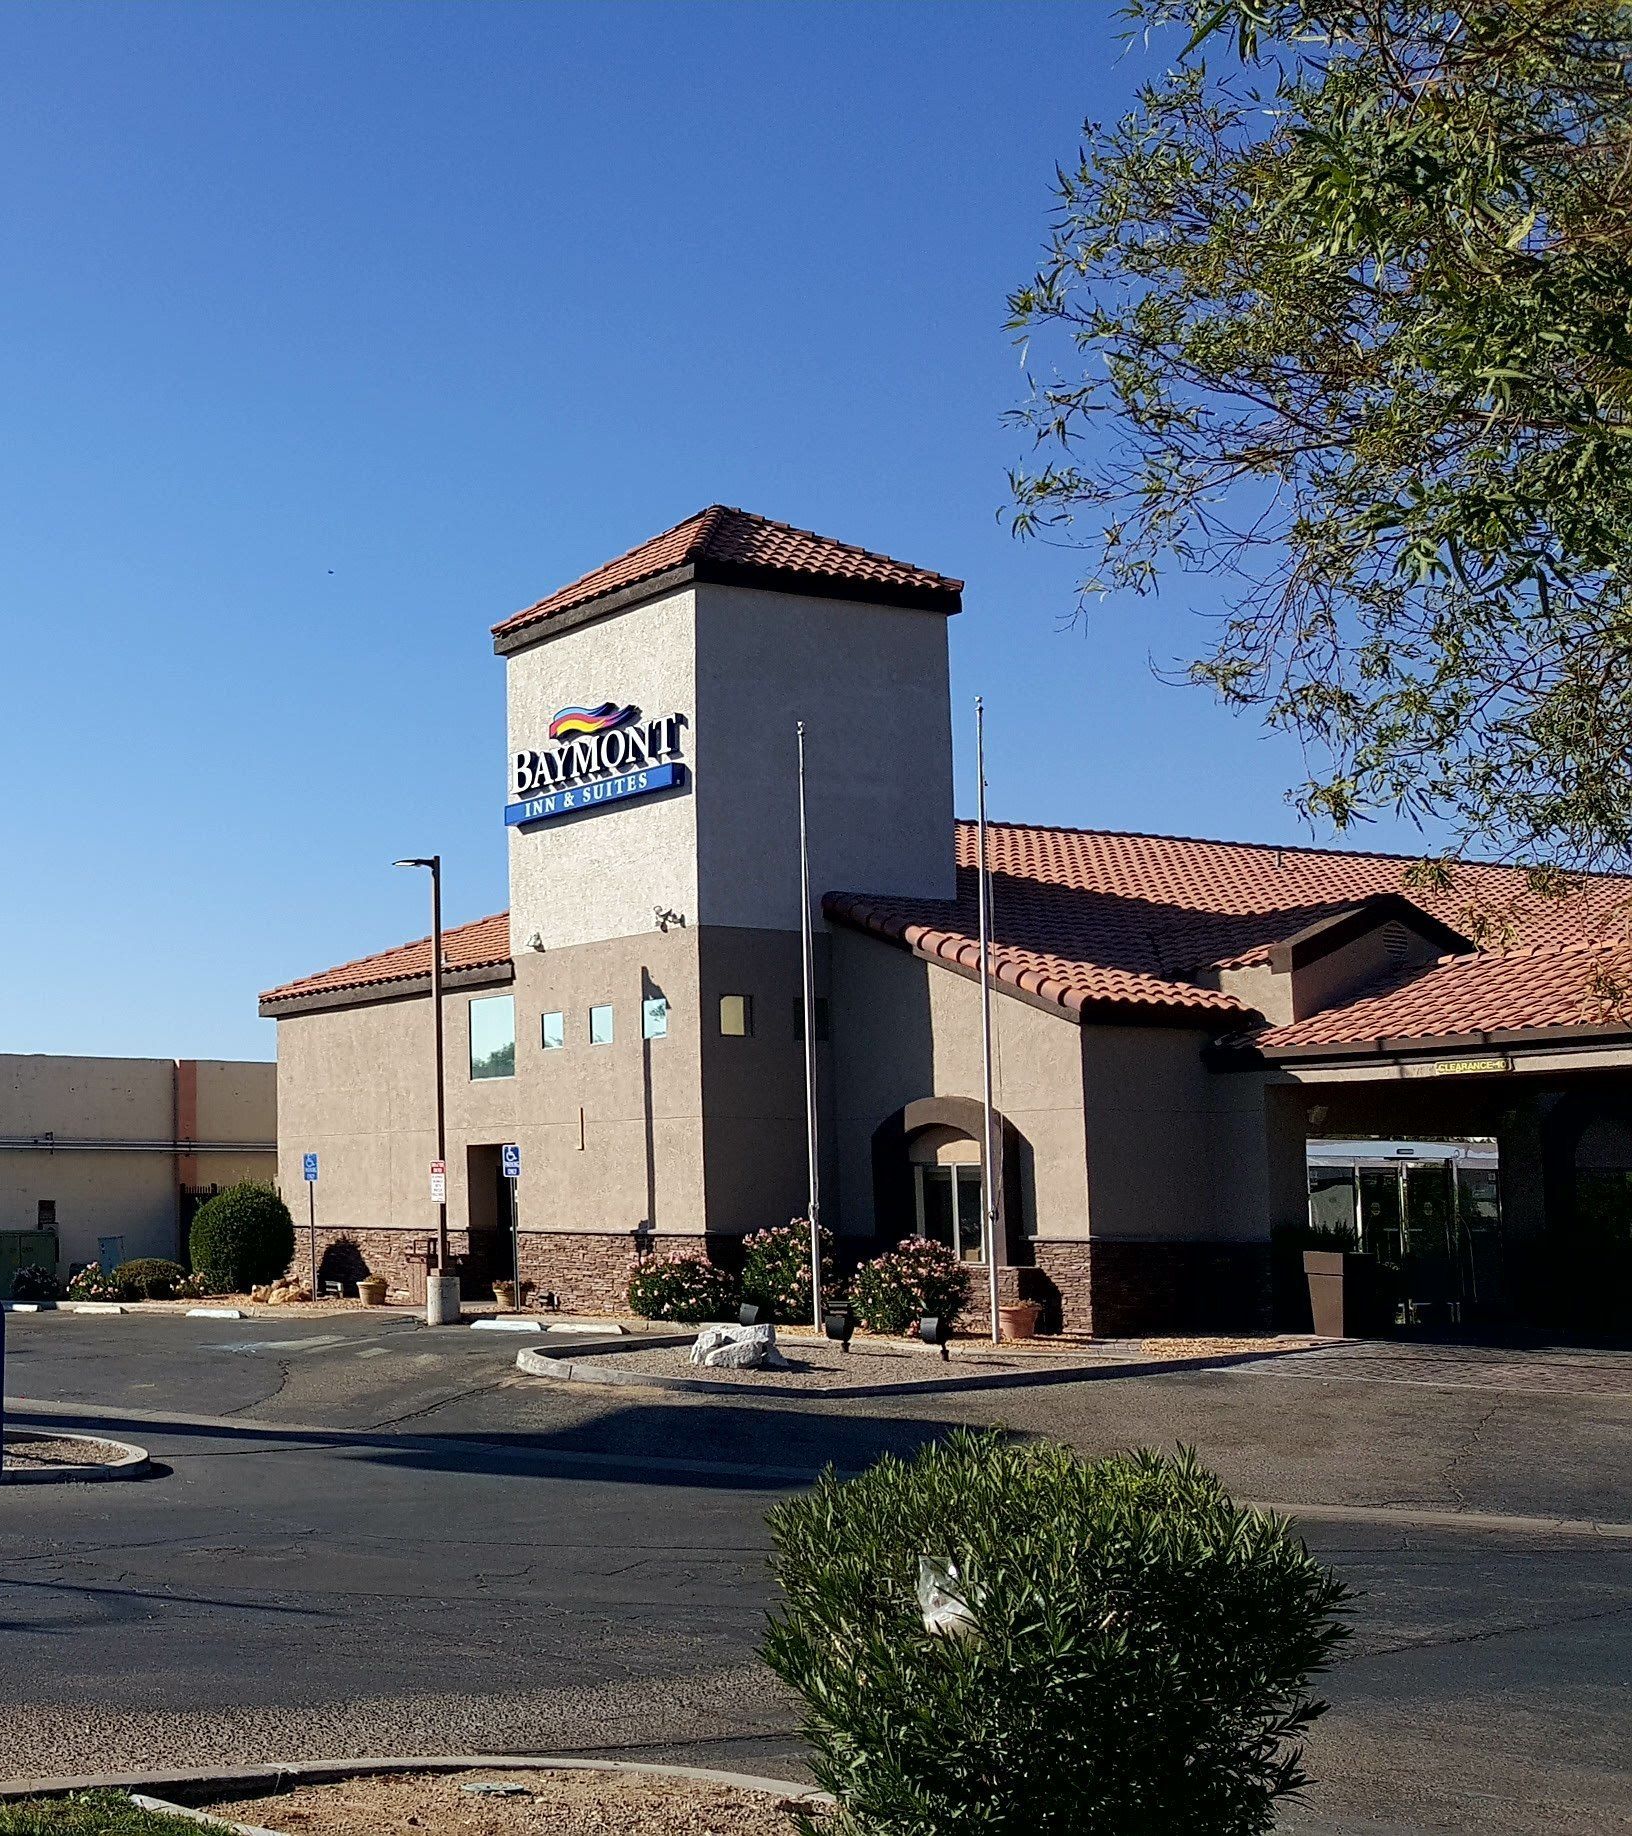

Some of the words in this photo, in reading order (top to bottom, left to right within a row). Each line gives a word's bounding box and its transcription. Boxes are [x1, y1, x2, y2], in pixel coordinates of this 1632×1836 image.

[509, 714, 677, 795] BAYMONT
[524, 798, 556, 818] INN
[563, 792, 575, 808] &
[582, 772, 648, 802] SUITES
